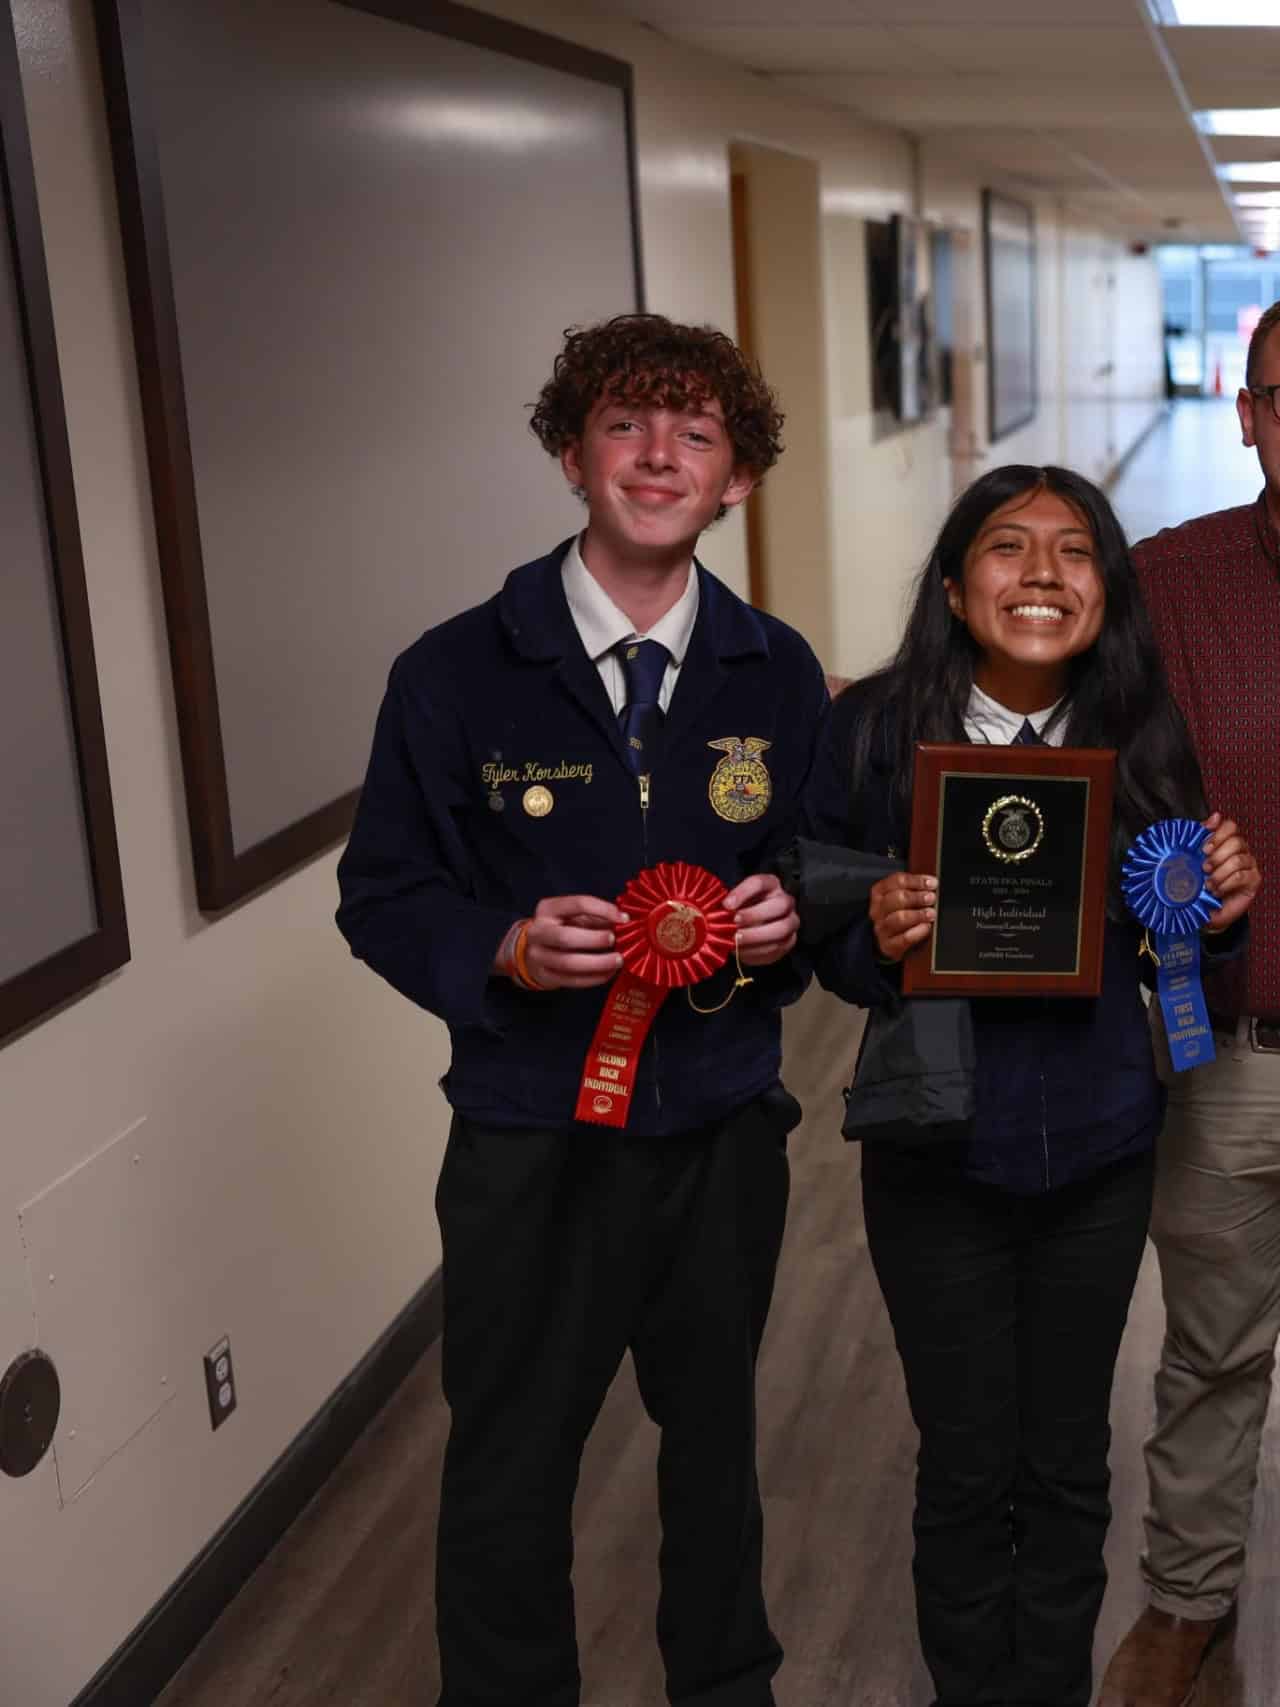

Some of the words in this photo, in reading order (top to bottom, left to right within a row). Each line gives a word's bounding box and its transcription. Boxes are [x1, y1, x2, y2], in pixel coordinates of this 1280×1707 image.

[482, 761, 521, 789] Tyler
[733, 775, 754, 785] FFA
[972, 905, 997, 920] High
[999, 904, 1046, 919] Individual
[597, 1054, 628, 1067] SECOND
[584, 1077, 629, 1097] INDIVIDUAL
